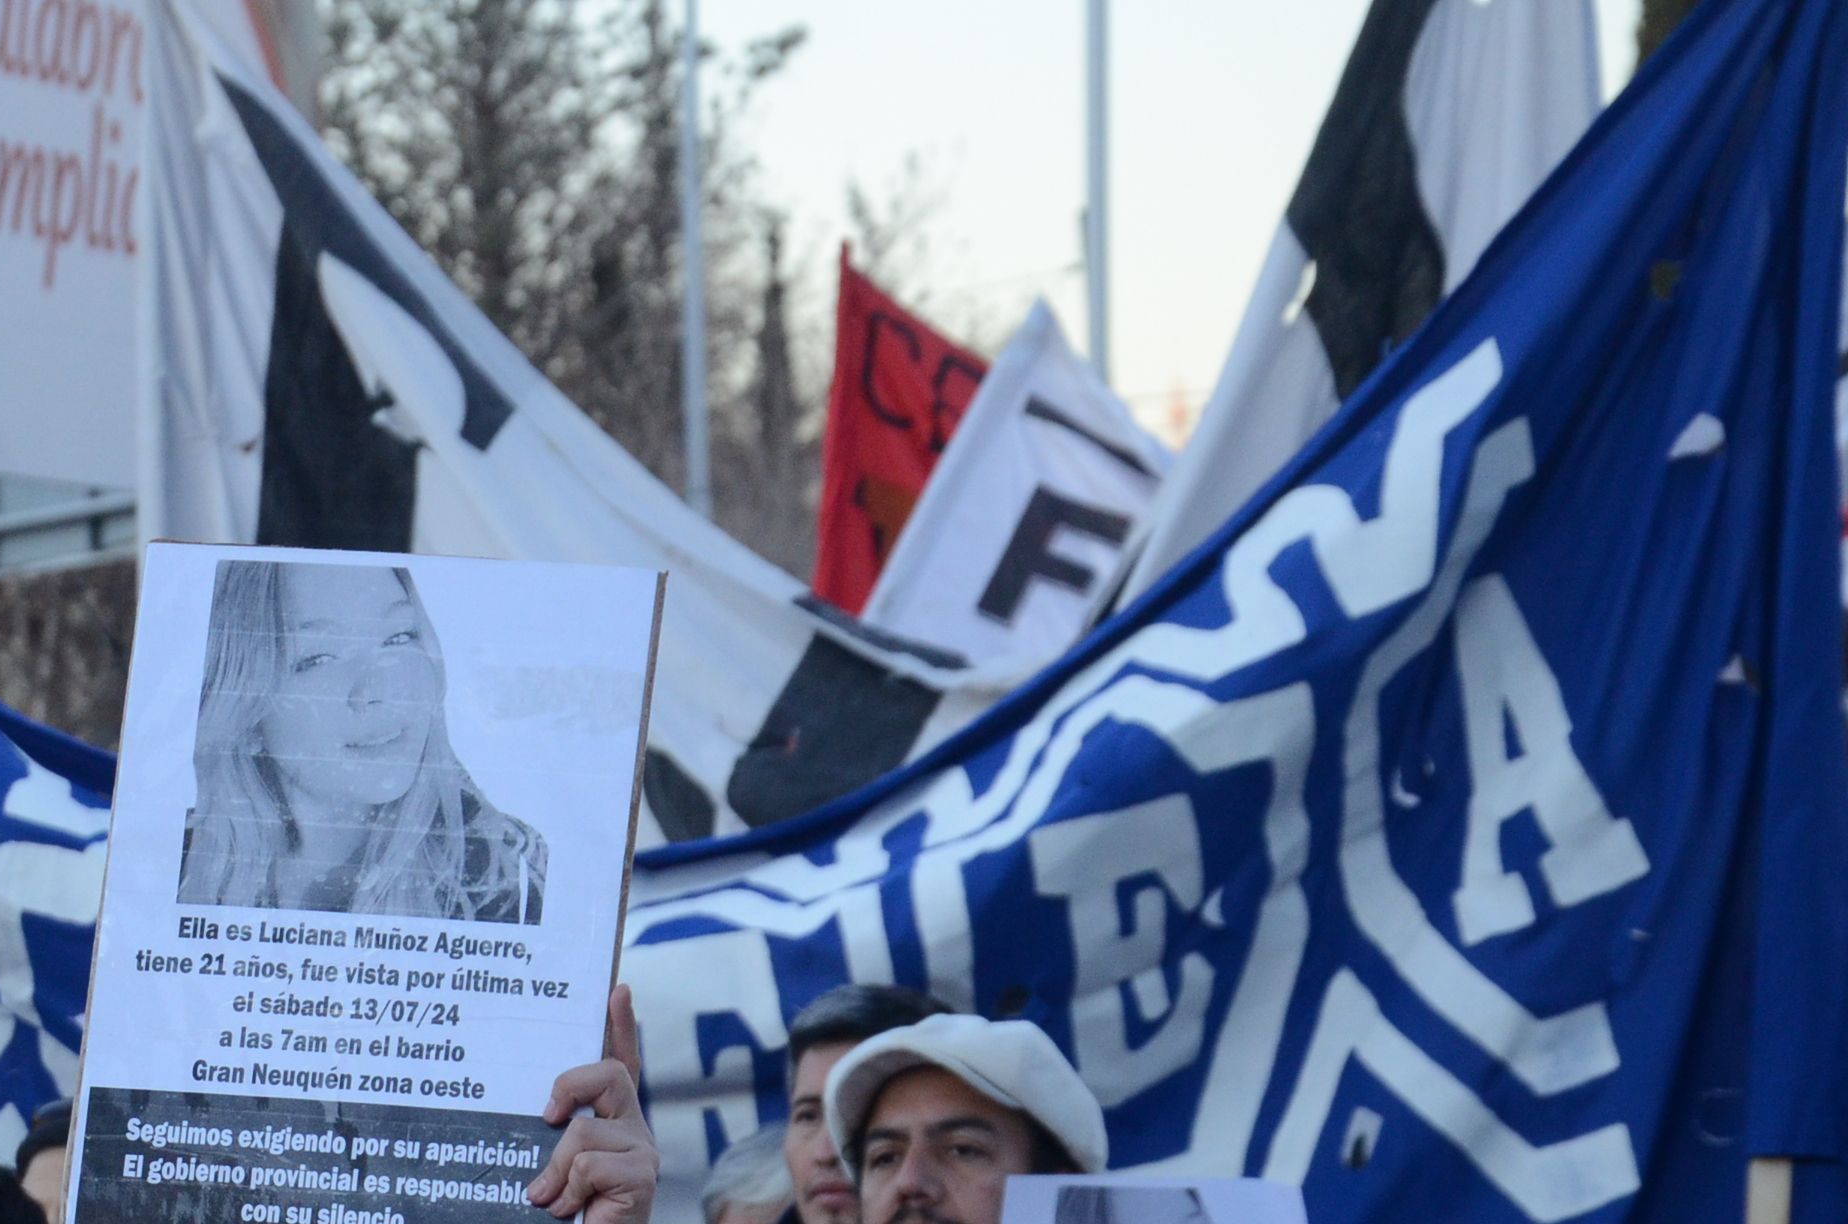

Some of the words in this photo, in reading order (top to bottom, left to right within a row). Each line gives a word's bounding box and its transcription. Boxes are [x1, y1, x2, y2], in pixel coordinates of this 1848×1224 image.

[179, 917, 218, 939] Ella
[226, 925, 251, 941] es
[259, 922, 346, 947] Luciana
[354, 927, 428, 952] Muñoz
[434, 932, 531, 965] Aguerre,
[136, 950, 192, 973] tiene
[199, 953, 226, 975] 21
[233, 955, 293, 984] años,
[301, 959, 337, 982] fue
[346, 962, 399, 986] vista
[406, 971, 445, 991] por
[451, 968, 523, 995] última
[532, 980, 569, 998] vez
[233, 992, 253, 1012] el
[260, 992, 343, 1017] sábado
[350, 998, 459, 1028] 13/07/24
[219, 1031, 232, 1047] a
[240, 1027, 272, 1049] las
[281, 1029, 327, 1052] 7am
[335, 1038, 361, 1055] en
[369, 1036, 390, 1056] el
[397, 1037, 465, 1062] barrio
[192, 1060, 244, 1083] Gran
[252, 1063, 352, 1092] Neuquén
[358, 1075, 412, 1094] zona
[420, 1077, 484, 1099] oeste
[126, 1118, 232, 1148] Seguimos
[238, 1126, 346, 1155] exigiendo
[351, 1137, 389, 1160] por
[393, 1140, 420, 1159] su
[425, 1134, 539, 1169] aparición!
[123, 1154, 143, 1177] El
[147, 1154, 248, 1188] gobierno
[250, 1164, 359, 1195] provincial
[364, 1175, 390, 1194] es
[241, 1204, 280, 1223] con
[286, 1207, 312, 1224] su
